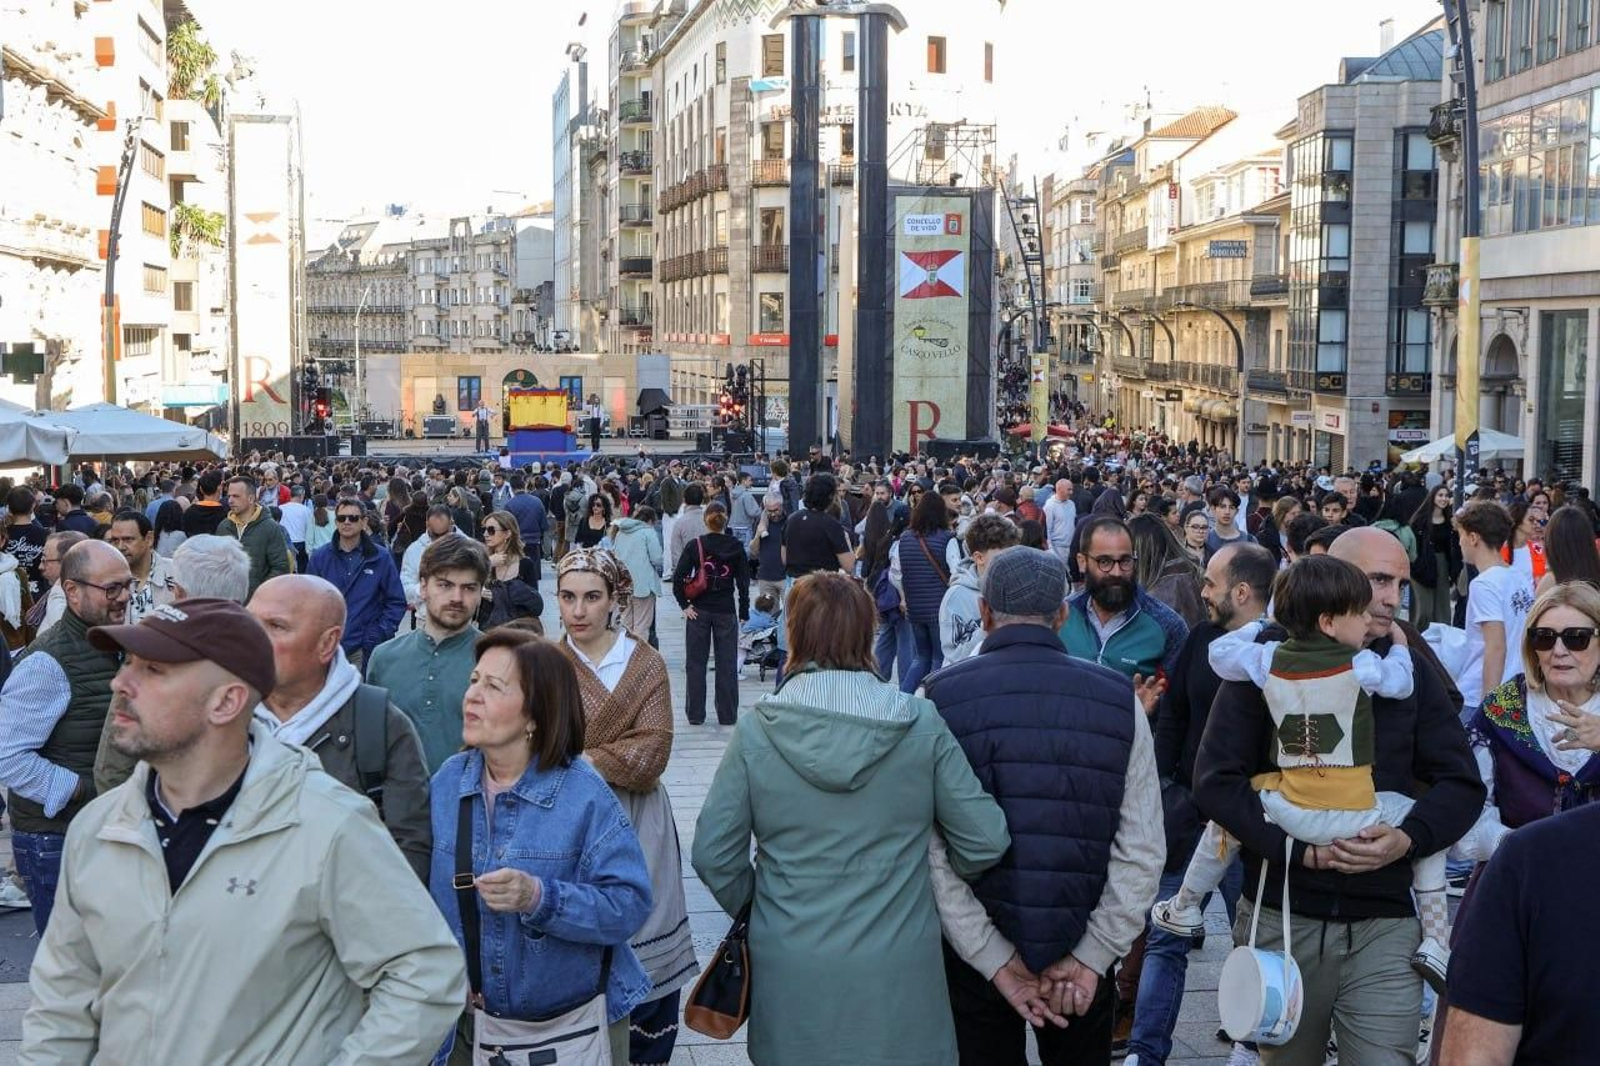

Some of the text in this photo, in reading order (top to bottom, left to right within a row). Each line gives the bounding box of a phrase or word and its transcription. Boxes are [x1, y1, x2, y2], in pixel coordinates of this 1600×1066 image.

[906, 217, 942, 225] CONCELLO
[242, 353, 287, 404] R
[243, 421, 289, 437] 1809
